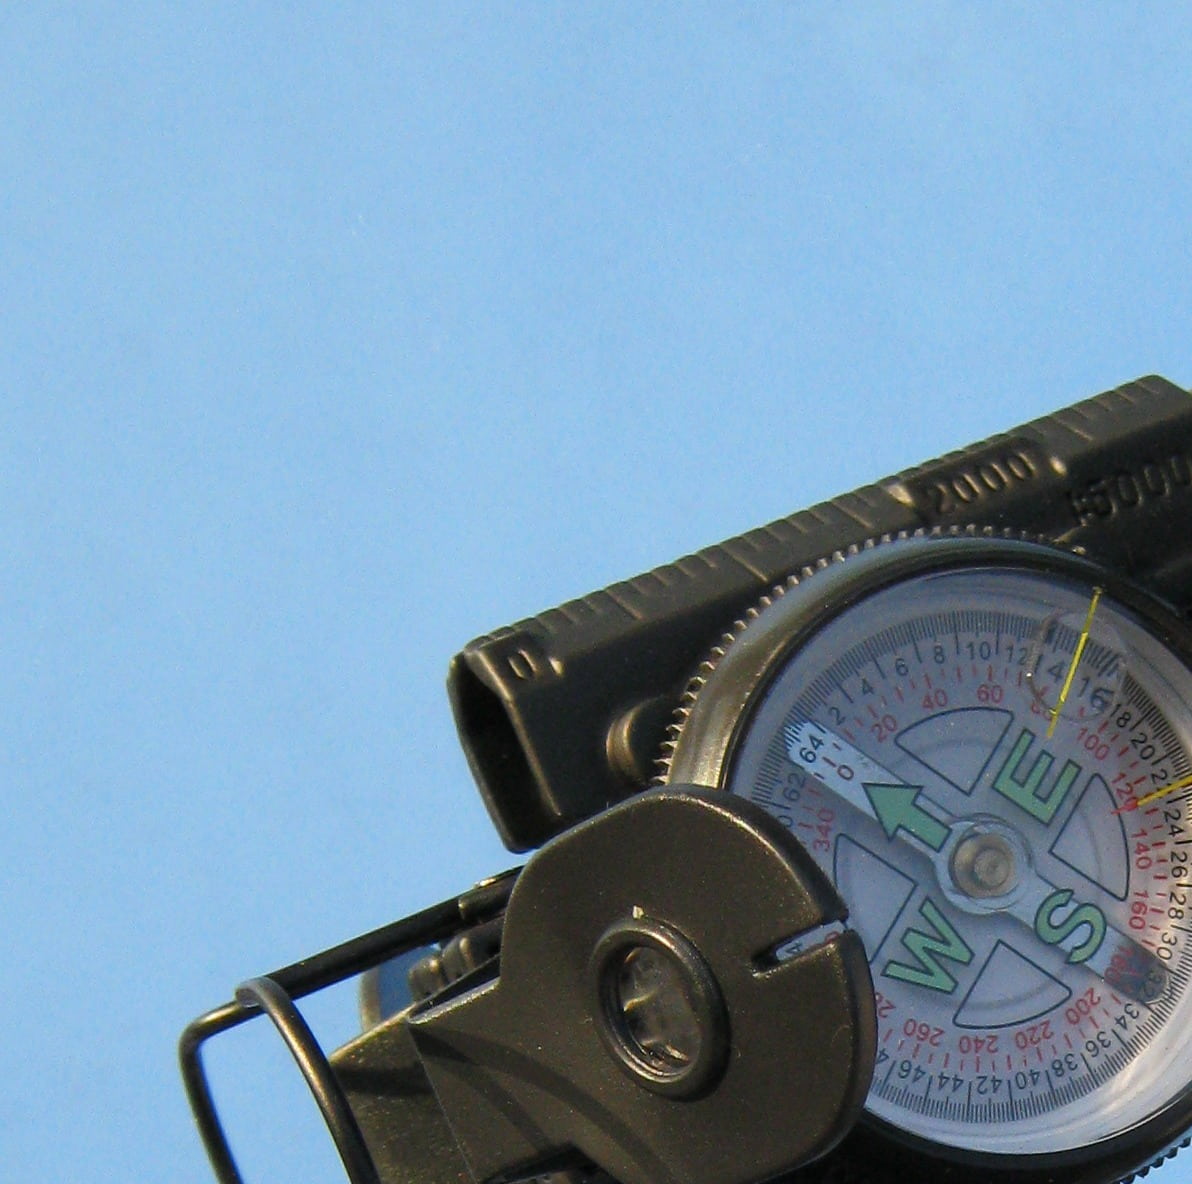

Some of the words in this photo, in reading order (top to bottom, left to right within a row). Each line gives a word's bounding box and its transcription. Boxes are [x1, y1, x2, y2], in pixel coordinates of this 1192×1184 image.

[933, 645, 946, 665] 8
[967, 640, 992, 661] 10
[895, 658, 909, 677] 6
[860, 678, 874, 697] 4
[922, 688, 949, 711] 40
[976, 683, 1004, 705] 60
[828, 705, 846, 726] 2
[870, 713, 898, 743] 20
[1109, 702, 1132, 730] 18
[798, 733, 825, 764] 64
[1077, 726, 1109, 761] 100
[1130, 732, 1156, 761] 20
[783, 772, 807, 801] 62
[837, 763, 855, 781] 0
[991, 728, 1083, 827] E
[813, 806, 835, 852] 340
[1163, 808, 1185, 838] 24
[1131, 829, 1151, 870] 140
[1169, 850, 1188, 879] 26
[1128, 889, 1149, 930] 160
[1167, 892, 1187, 921] 28
[1034, 887, 1108, 965] S
[880, 896, 976, 996] W
[1156, 931, 1178, 961] 30
[1065, 987, 1102, 1026] 200
[1114, 1001, 1141, 1029] 34
[903, 1017, 945, 1047] 260
[958, 1034, 1000, 1055] 240
[1014, 1019, 1054, 1049] 220
[1085, 1030, 1113, 1058] 36
[898, 1059, 926, 1083] 46
[1014, 1068, 1041, 1090] 40
[1051, 1052, 1079, 1078] 38
[938, 1074, 964, 1093] 44
[976, 1075, 1002, 1095] 42
